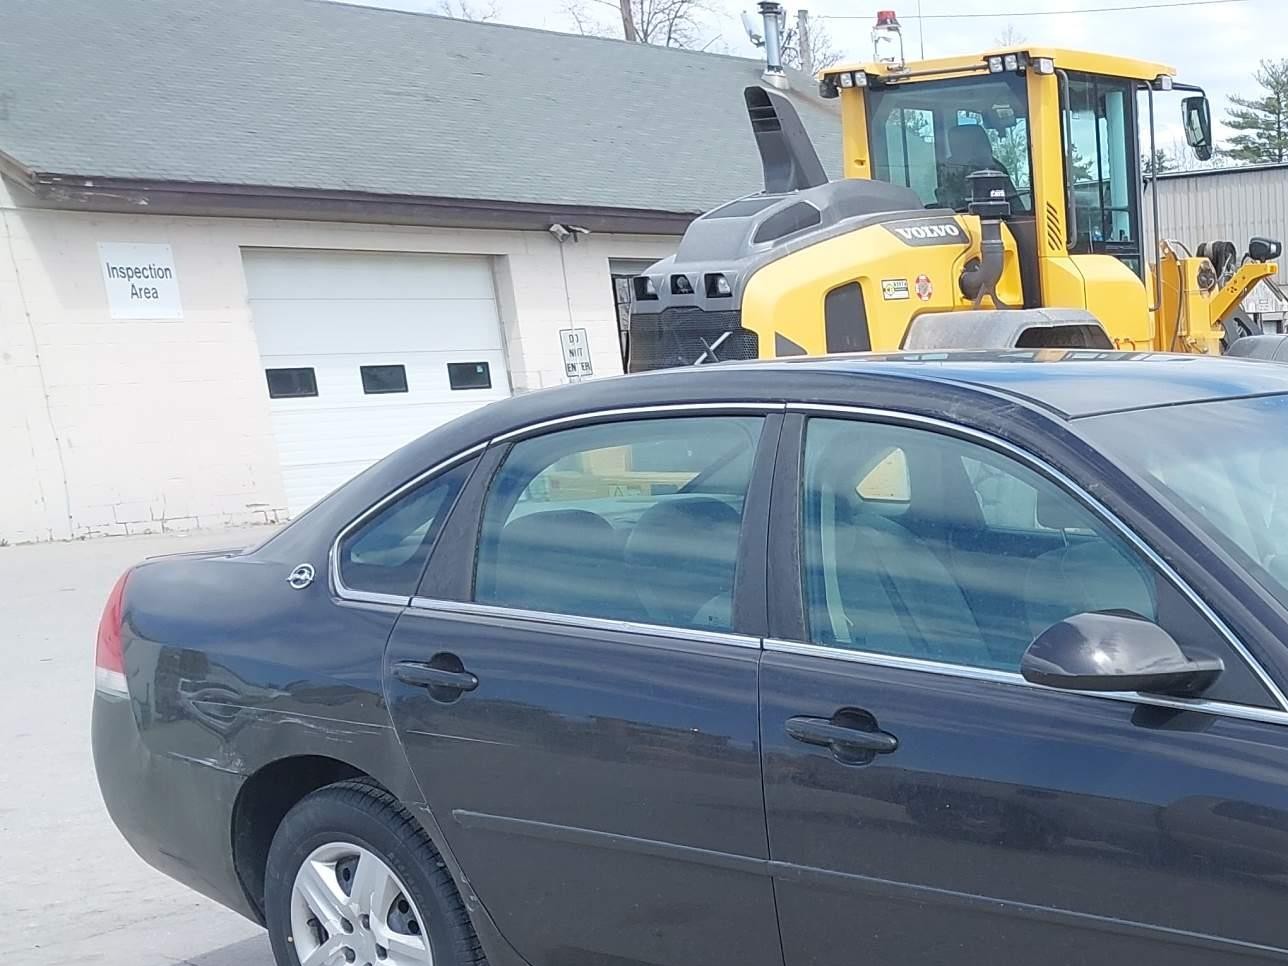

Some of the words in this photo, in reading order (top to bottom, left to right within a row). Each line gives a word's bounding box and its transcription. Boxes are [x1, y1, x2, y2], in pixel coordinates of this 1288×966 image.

[895, 224, 960, 239] VOLVO
[106, 262, 172, 282] Inspection
[131, 283, 159, 299] Area
